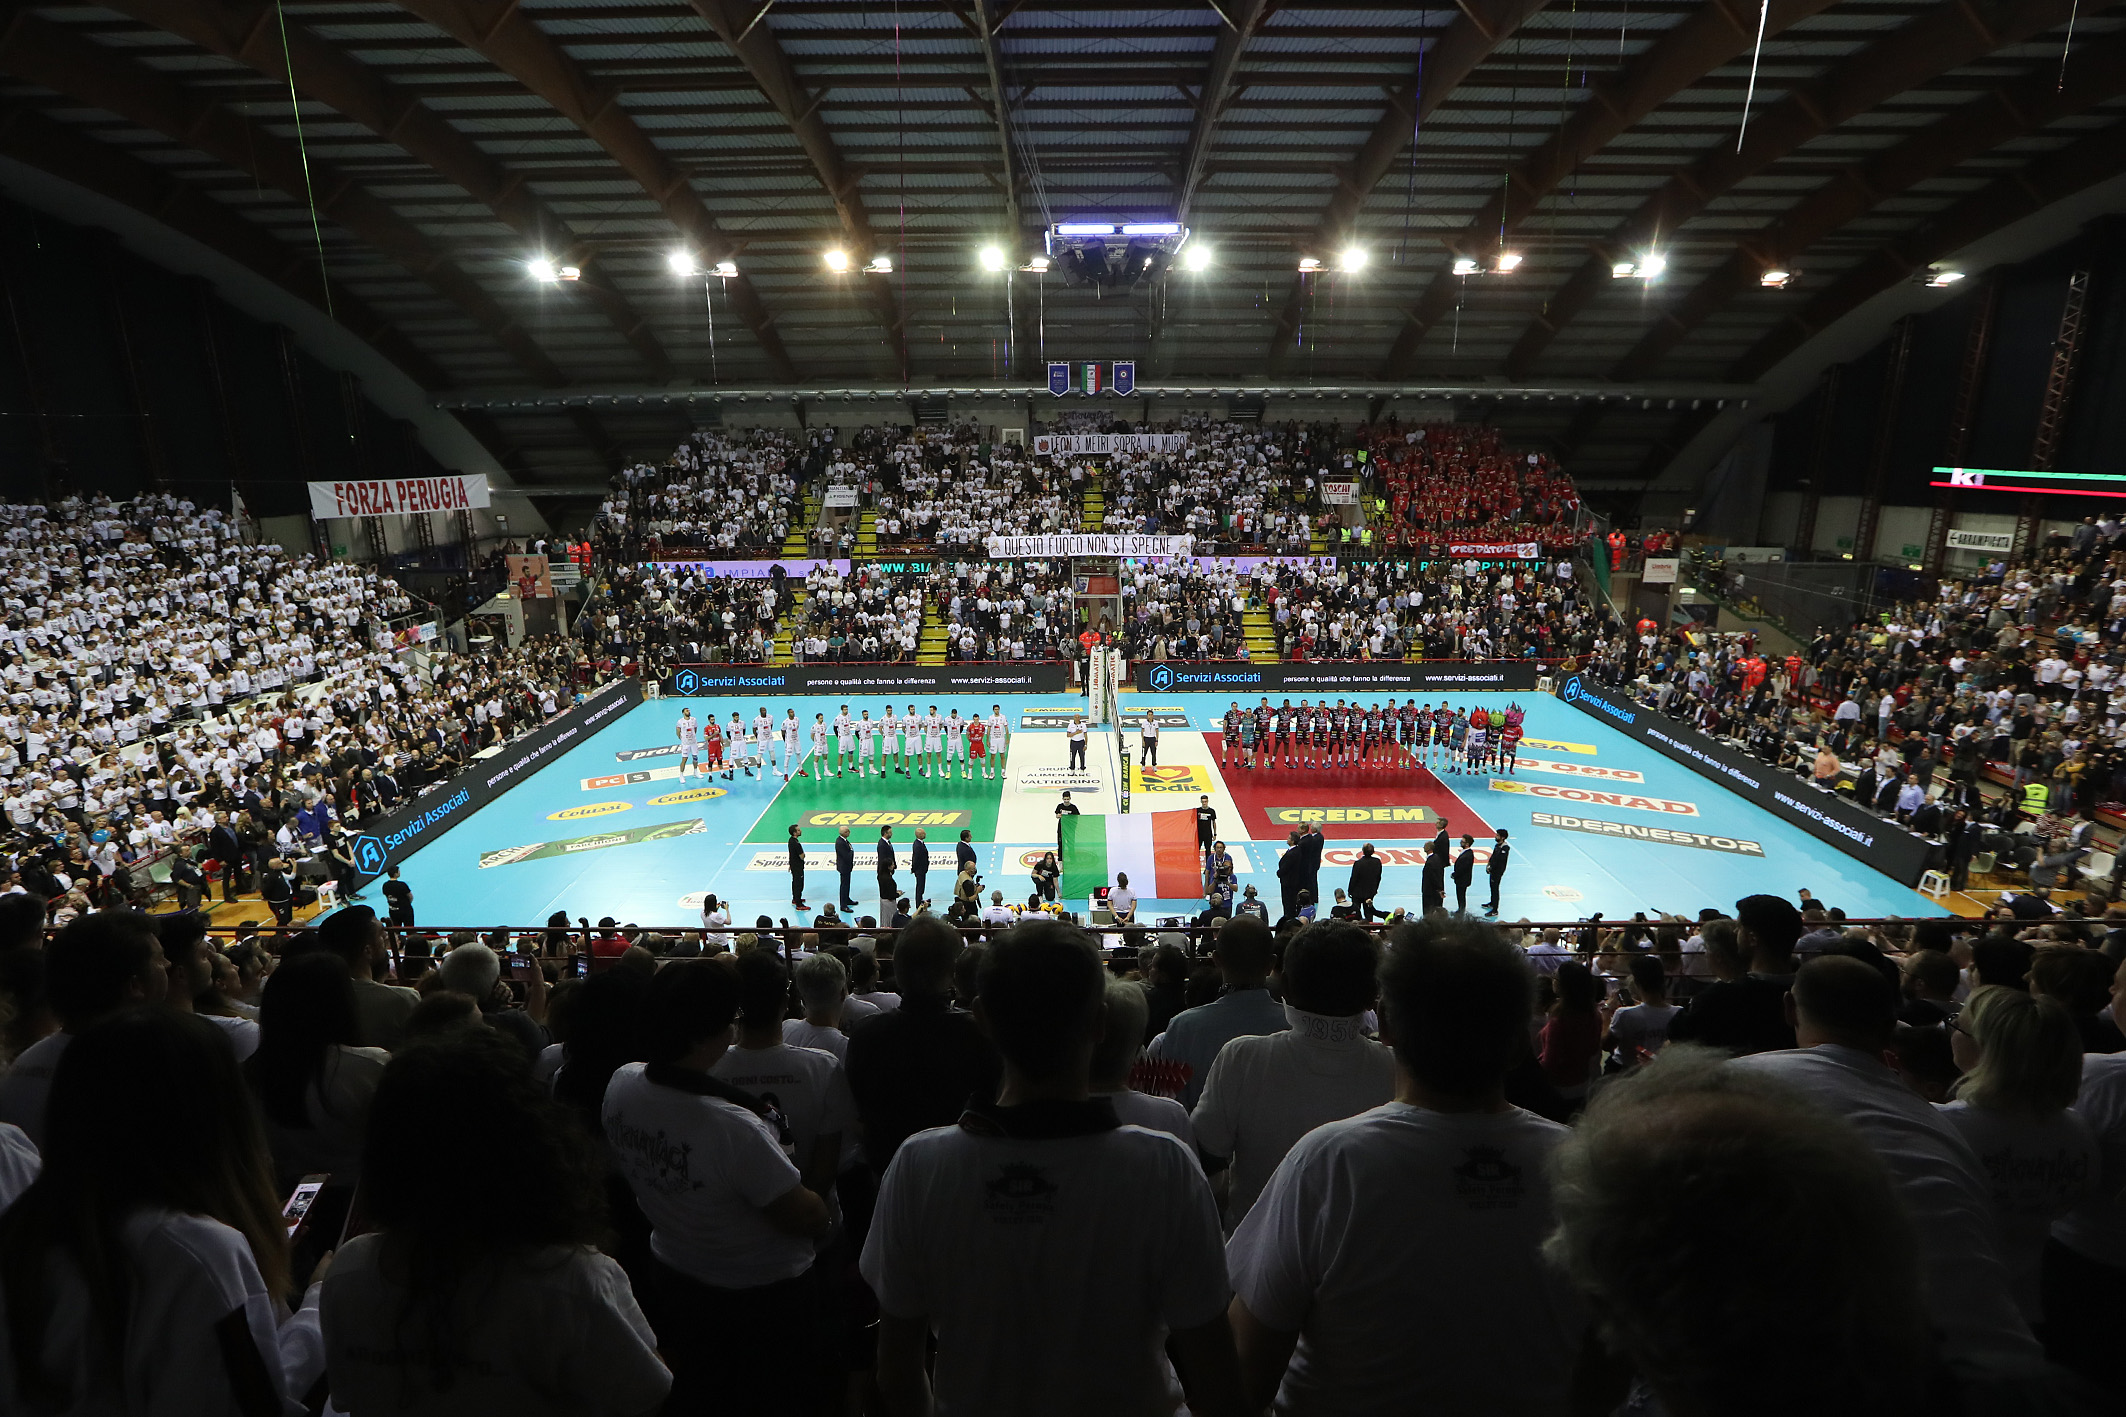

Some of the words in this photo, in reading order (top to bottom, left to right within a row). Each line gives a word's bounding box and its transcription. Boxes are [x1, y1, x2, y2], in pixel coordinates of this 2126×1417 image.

[1050, 436, 1072, 452] LEON
[1075, 436, 1081, 452] 3
[1086, 436, 1109, 452] METRI
[1114, 436, 1142, 452] SOPRA
[334, 481, 395, 516] FORZA
[396, 477, 470, 512] PERUGIA
[1004, 537, 1044, 555] QUESTO
[1048, 537, 1083, 554] FUOCO
[1087, 537, 1109, 554] NON
[1113, 537, 1125, 554] SI
[1131, 537, 1172, 555] SPEGNE
[701, 676, 735, 686] Servizi
[738, 676, 785, 686] Associati
[807, 679, 833, 687] persone
[950, 675, 1032, 684] www.servizi-associati.it
[1176, 672, 1212, 682] Servizi
[1214, 672, 1261, 682] Associati
[1425, 674, 1504, 682] www.servizi-associati.it
[1579, 689, 1604, 707] Servizi
[1601, 701, 1636, 724] Associati
[486, 770, 509, 788] persone
[530, 750, 540, 760] che
[539, 742, 553, 754] fanno
[556, 727, 578, 744] differenza
[1647, 728, 1669, 743] persone
[1691, 750, 1703, 760] che
[1703, 754, 1721, 769] fanno
[1728, 768, 1760, 790] differenza
[1551, 763, 1640, 779] OMO
[1140, 783, 1202, 792] Todis
[657, 789, 717, 804] Colussi
[1530, 786, 1695, 814] CONAD
[384, 815, 426, 850] Servizi
[425, 787, 470, 826] Associati
[557, 803, 622, 819] Colussi
[809, 812, 963, 825] CREDEM
[1278, 808, 1425, 822] CREDEM
[1532, 812, 1762, 853] SIDERNESTOR
[1101, 887, 1107, 897] 0
[1301, 1015, 1360, 1042] 1956
